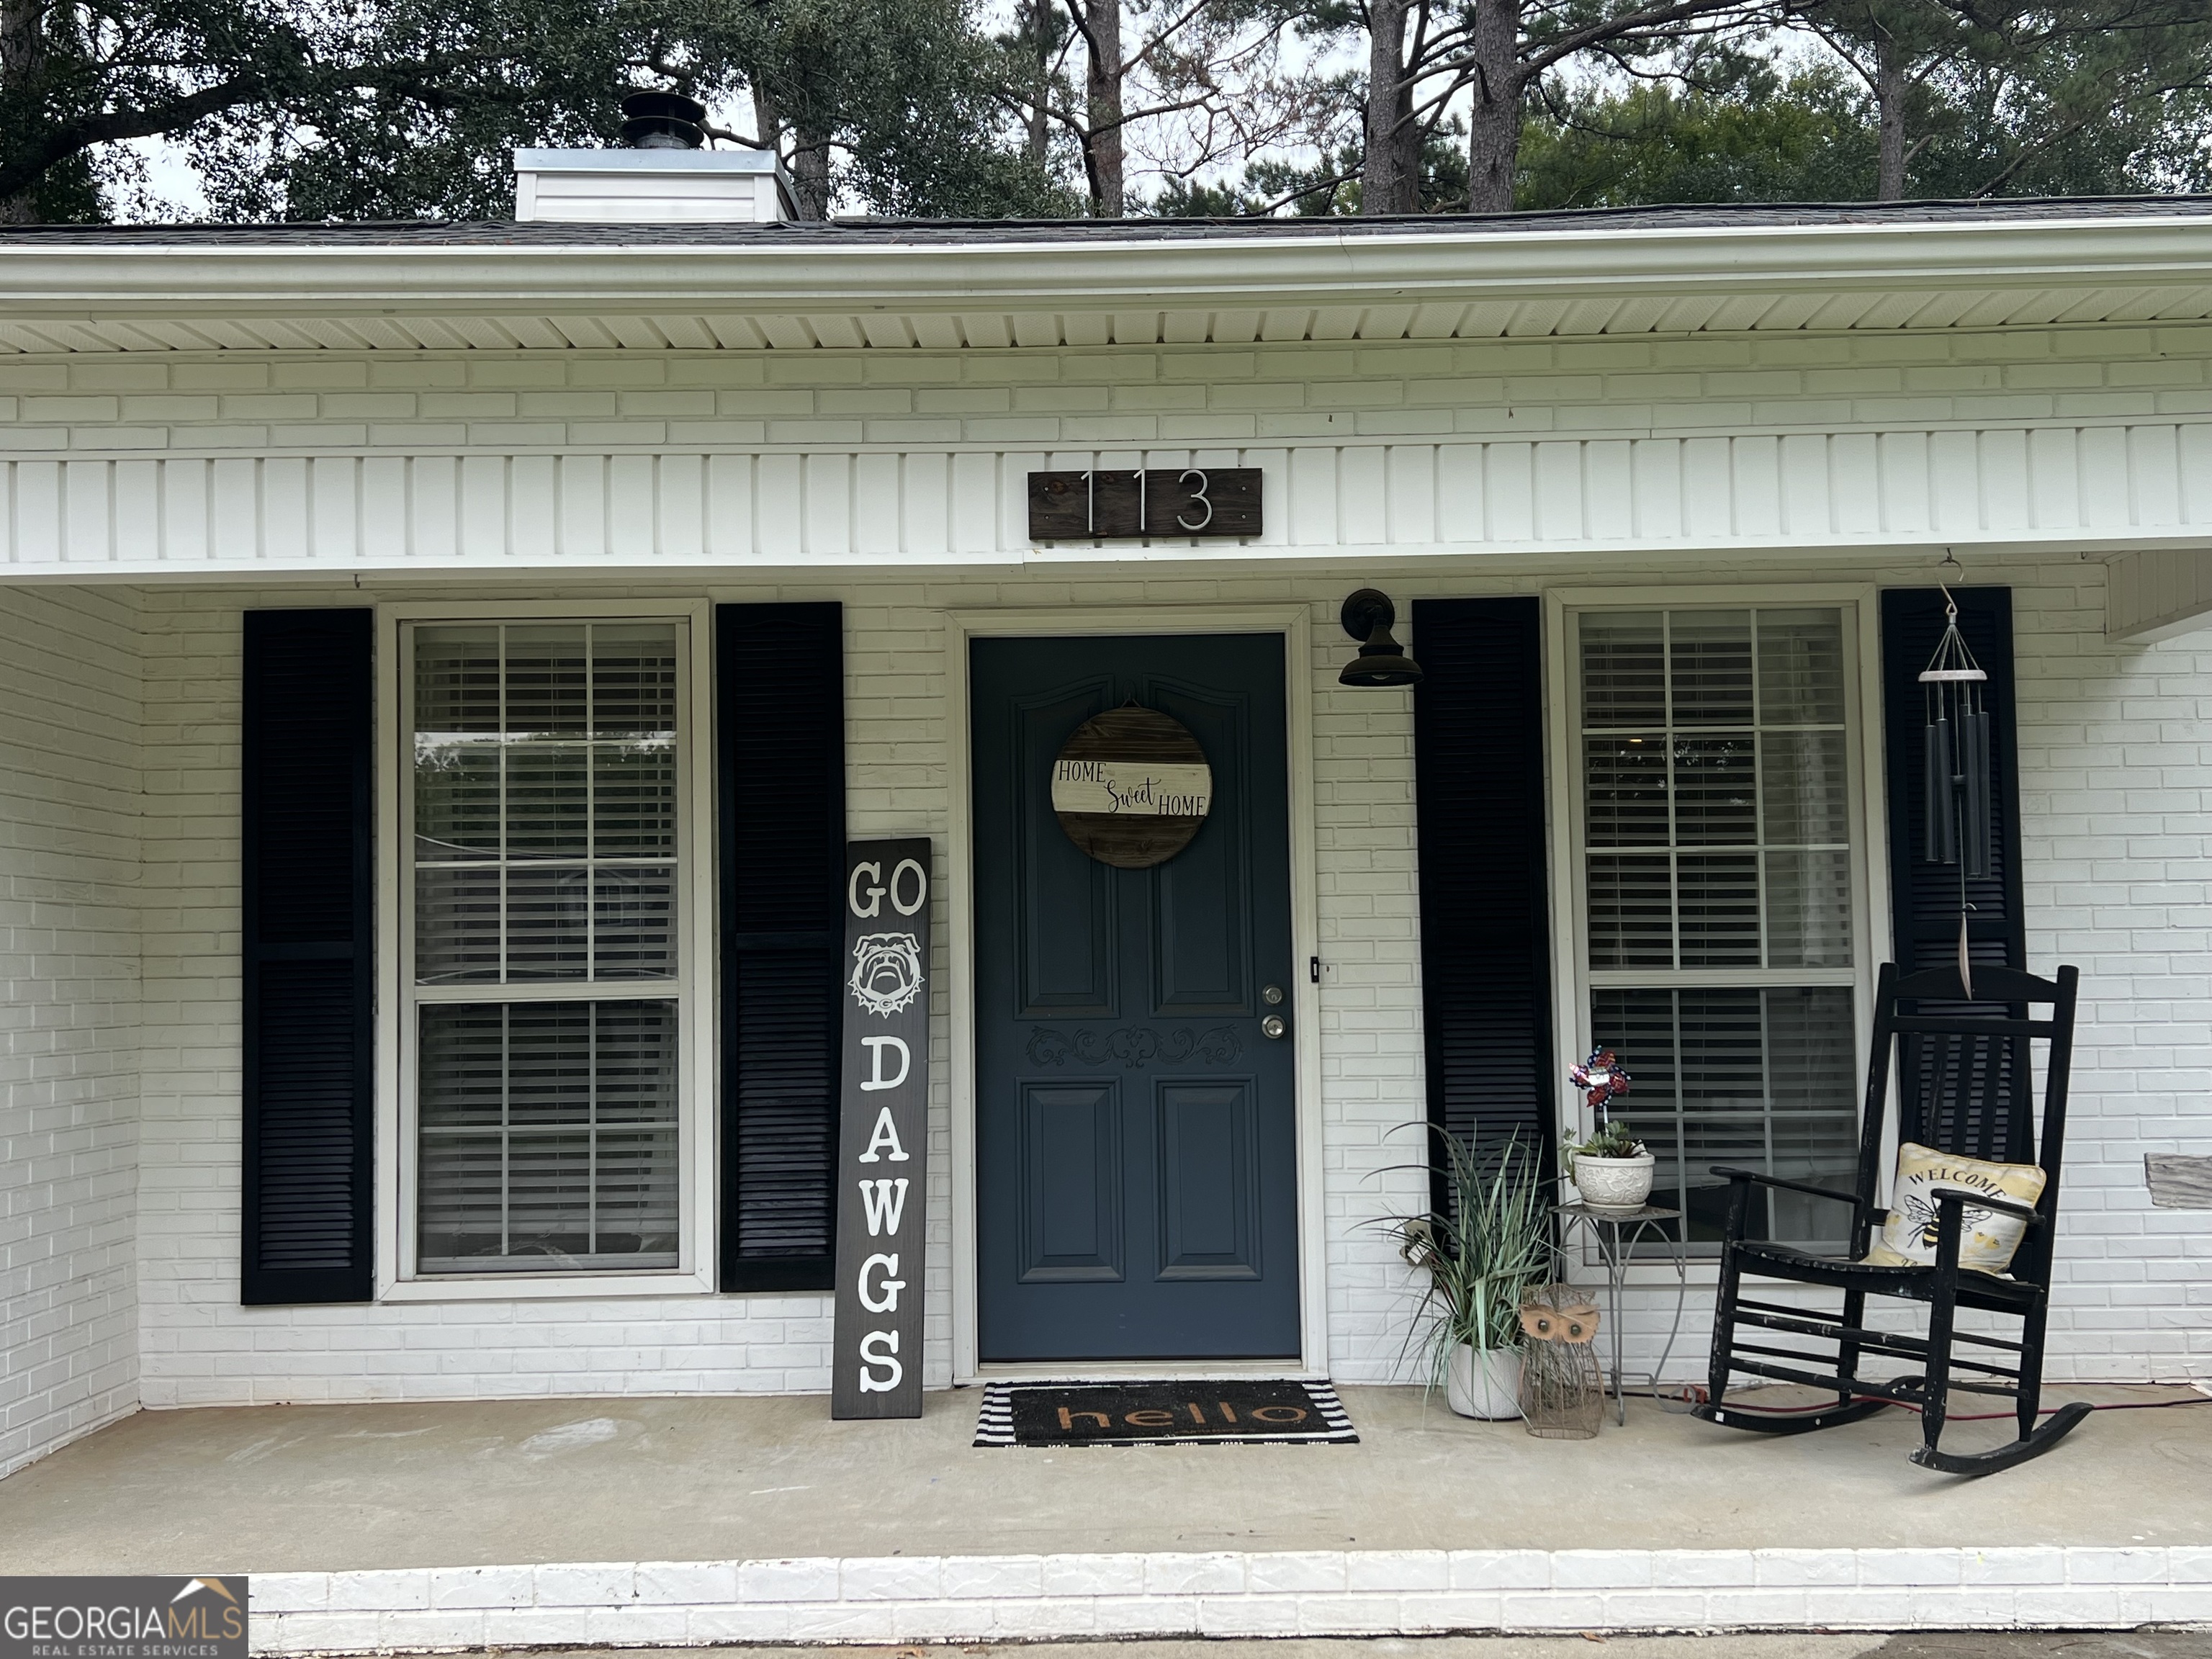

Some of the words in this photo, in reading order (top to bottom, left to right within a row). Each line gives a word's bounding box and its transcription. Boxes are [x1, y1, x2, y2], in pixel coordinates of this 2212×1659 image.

[1081, 469, 1213, 534] 113
[1058, 760, 1107, 783] HOME
[1103, 777, 1161, 814] Sweet
[1158, 794, 1206, 817] HOME
[848, 858, 927, 918] GO
[858, 1035, 911, 1393] DAWGS
[1057, 1401, 1307, 1430] hello
